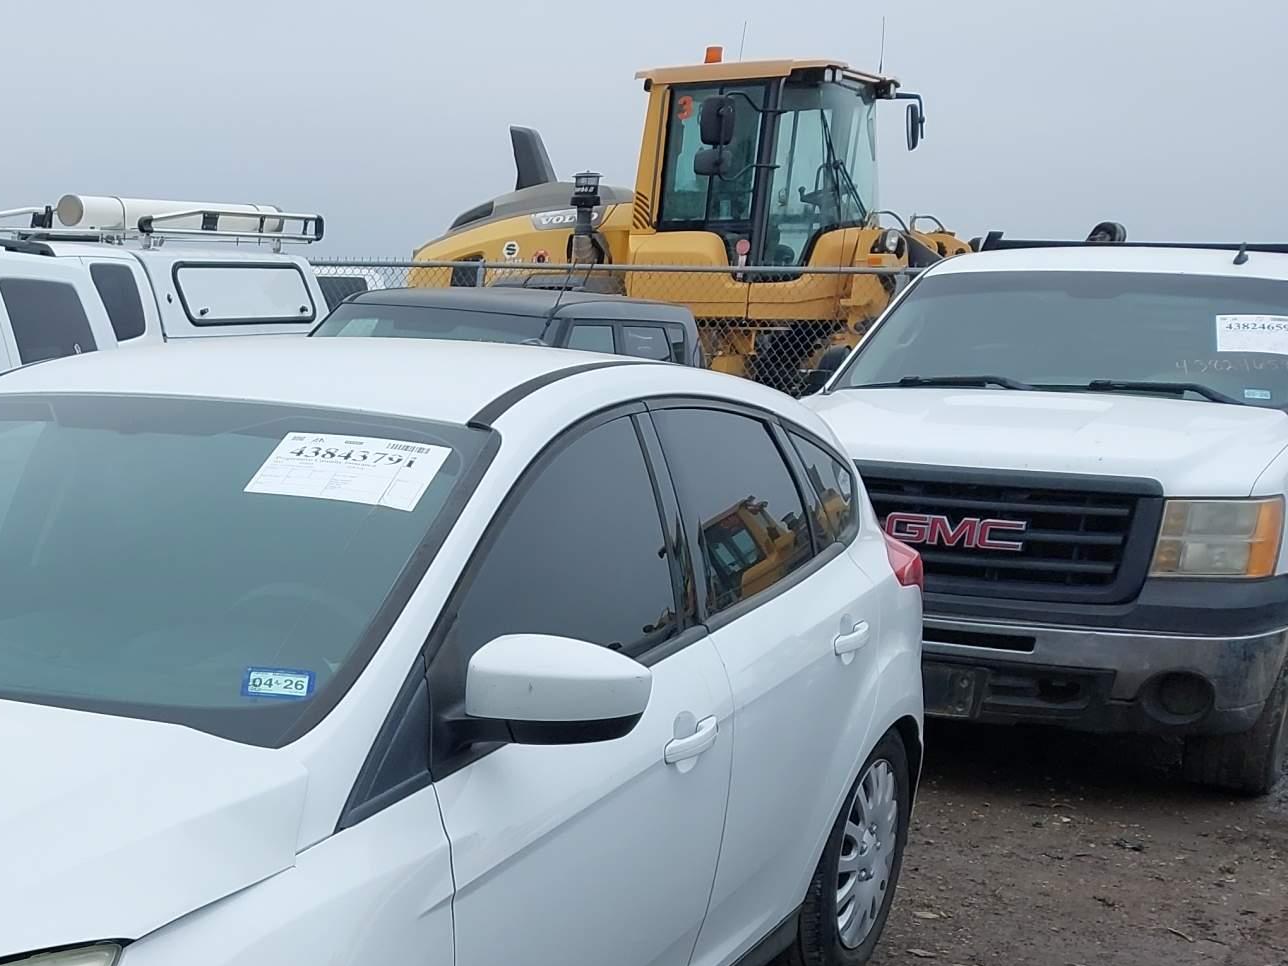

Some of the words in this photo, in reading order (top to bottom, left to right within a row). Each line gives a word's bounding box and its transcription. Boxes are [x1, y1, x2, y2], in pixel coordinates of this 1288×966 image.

[678, 95, 693, 120] 3
[290, 446, 418, 468] 43843791
[885, 511, 1027, 551] GMC
